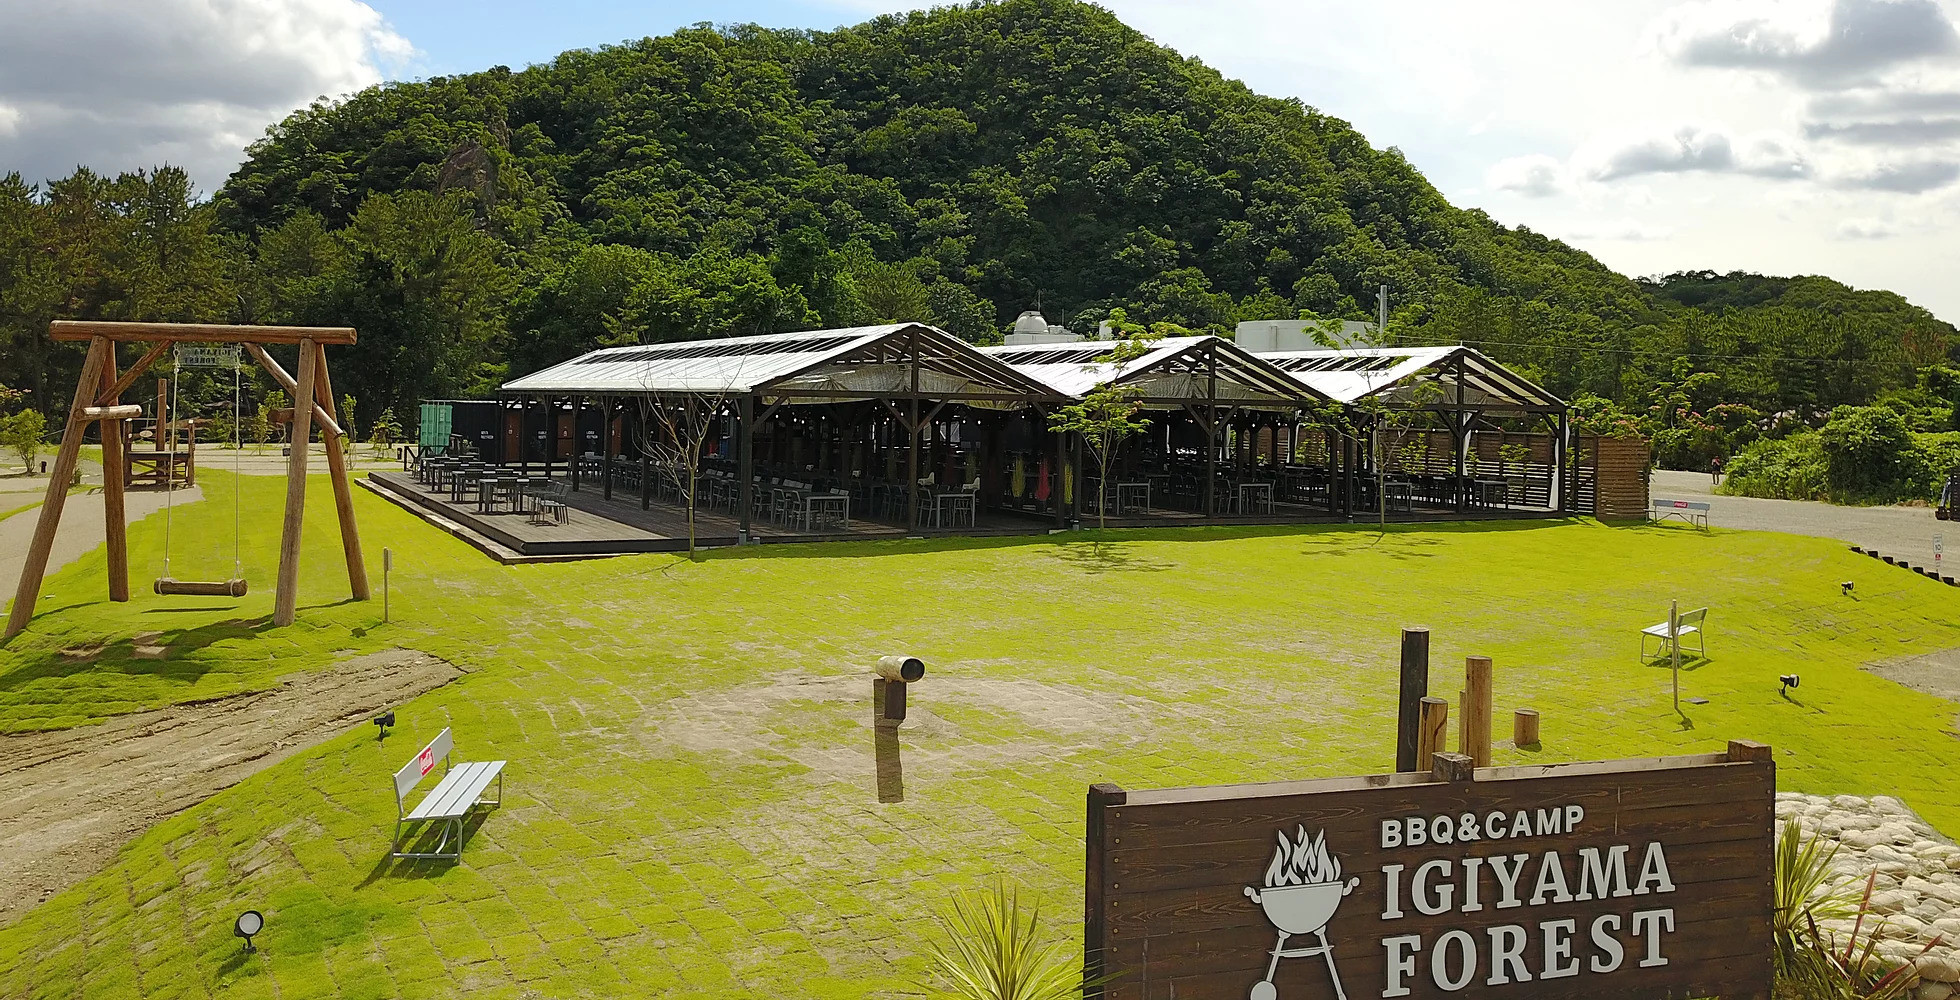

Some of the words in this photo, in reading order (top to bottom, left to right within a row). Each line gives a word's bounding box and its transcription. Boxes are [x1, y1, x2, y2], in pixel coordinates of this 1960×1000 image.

[1381, 805, 1584, 848] BBQ&CAMP
[1381, 842, 1676, 920] IGIYAMA
[1382, 908, 1675, 998] FOREST
